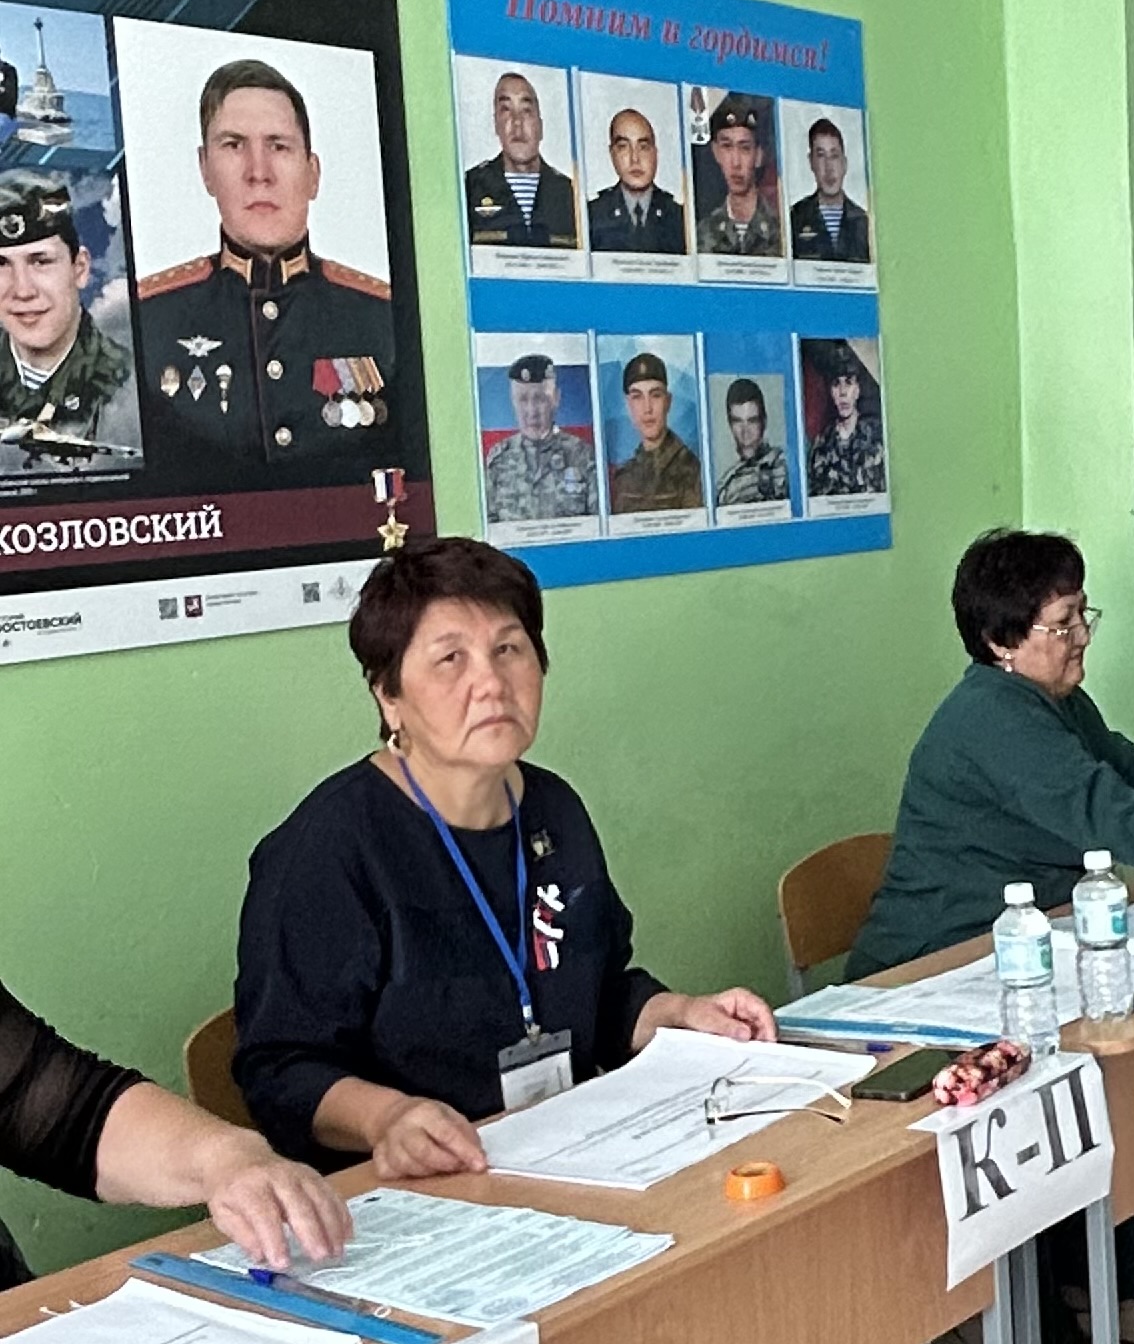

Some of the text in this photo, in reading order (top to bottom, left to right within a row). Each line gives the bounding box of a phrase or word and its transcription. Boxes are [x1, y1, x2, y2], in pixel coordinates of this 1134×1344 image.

[661, 19, 682, 45] и
[688, 24, 829, 72] гордимся!
[0, 503, 224, 556] КОЗЛОВСКИЙ
[0, 612, 82, 634] ОСТОЕВСКИЙ
[949, 1064, 1102, 1221] К-П
